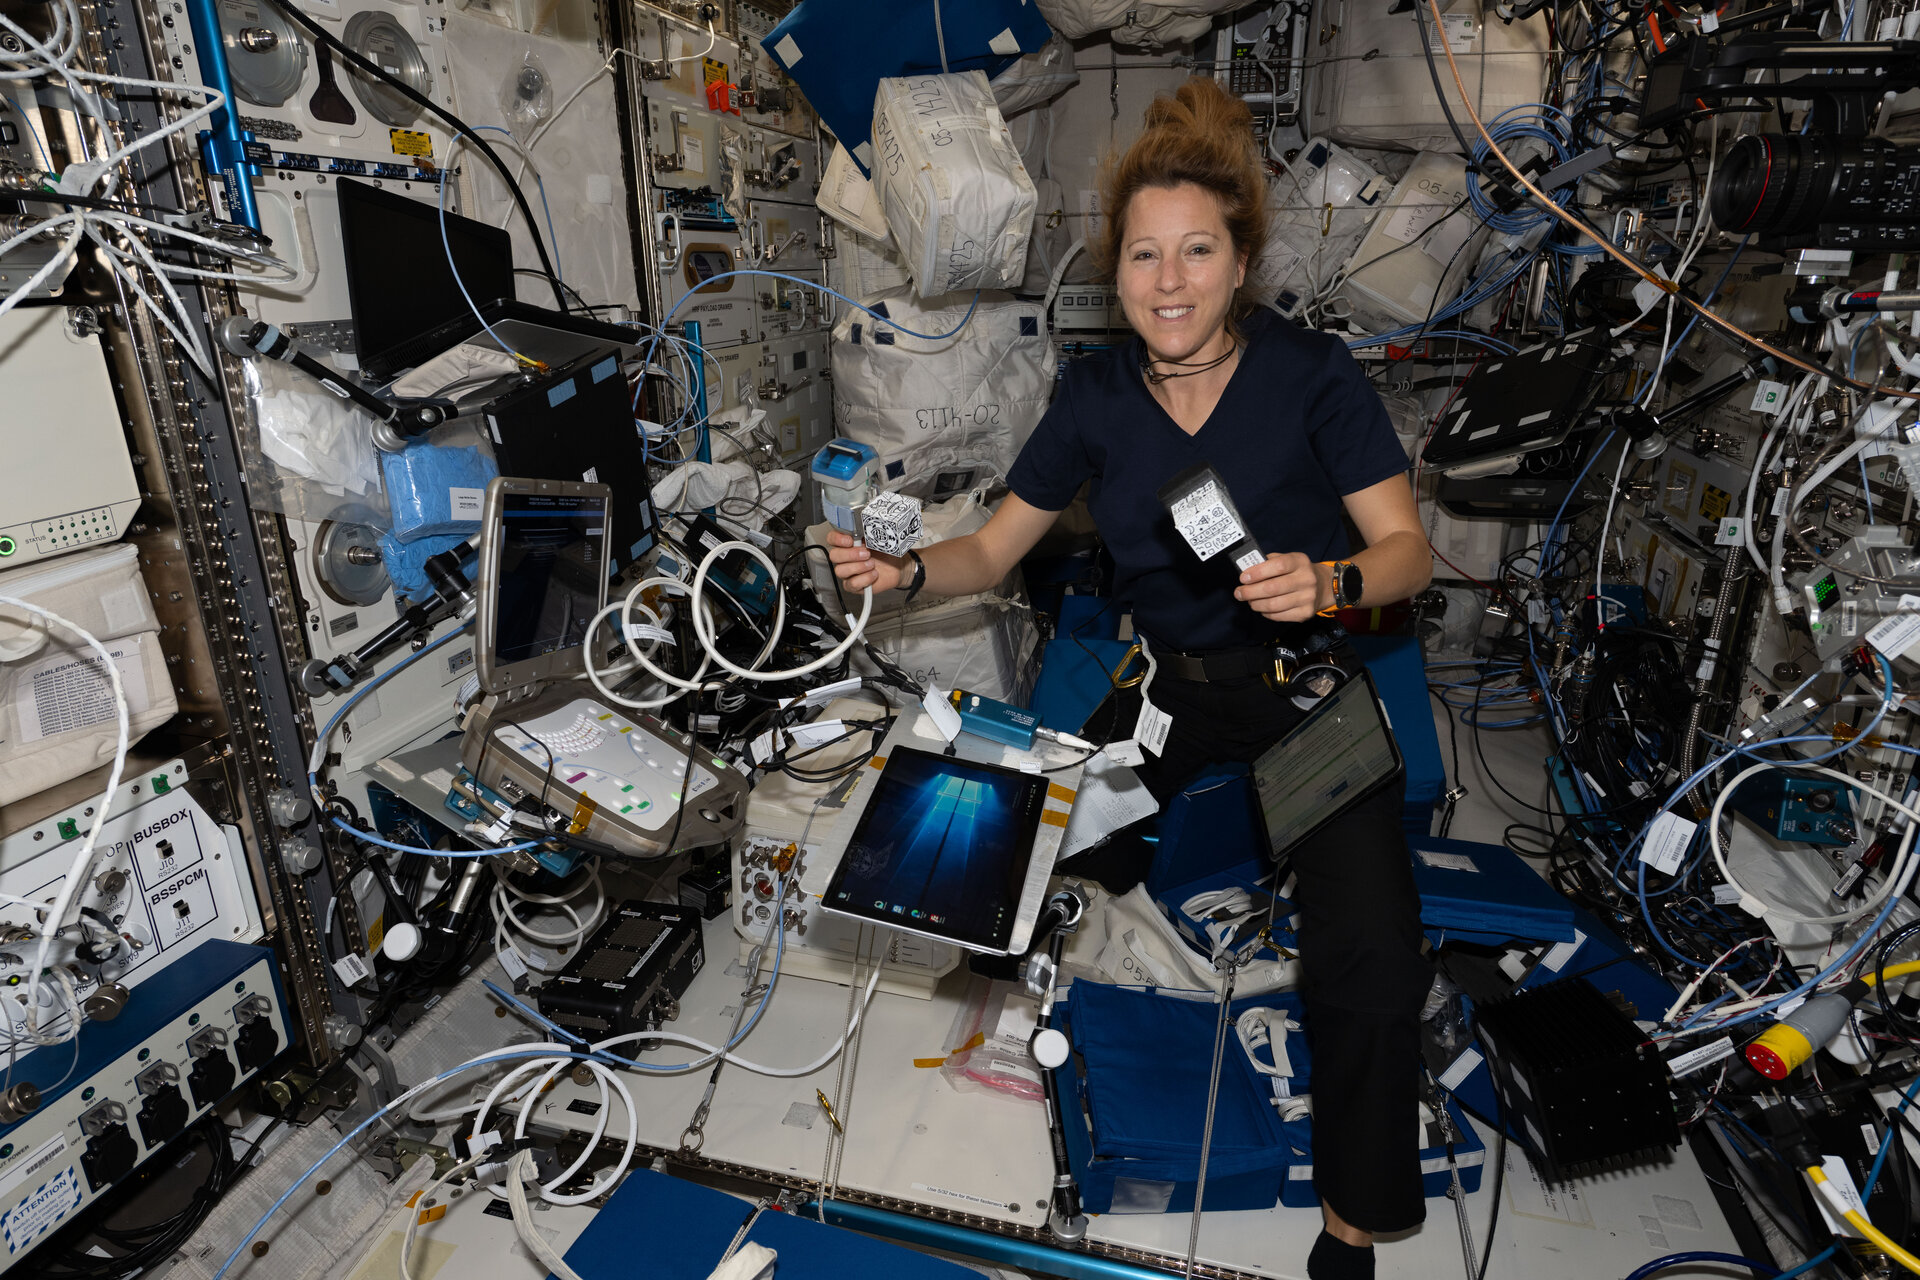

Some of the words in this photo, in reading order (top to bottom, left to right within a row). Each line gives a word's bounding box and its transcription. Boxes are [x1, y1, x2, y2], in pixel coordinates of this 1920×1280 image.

[25, 535, 46, 544] STATUS
[33, 656, 96, 680] CABLES/HOSES
[134, 808, 188, 844] BUSBOX
[159, 856, 175, 870] J10
[158, 864, 179, 878] RS232
[151, 868, 204, 906] BSSPCM
[176, 916, 191, 930] J11
[174, 923, 195, 938] RS232
[119, 950, 140, 968] SW9
[226, 1024, 235, 1032] OFF
[176, 1042, 184, 1050] ON
[179, 1058, 188, 1067] OFF
[124, 1079, 133, 1087] ON
[127, 1096, 138, 1105] OFF
[67, 1119, 76, 1128] ON
[70, 1136, 82, 1147] OFF
[8, 1144, 30, 1164] POWER
[12, 1178, 68, 1224] ATTENTION
